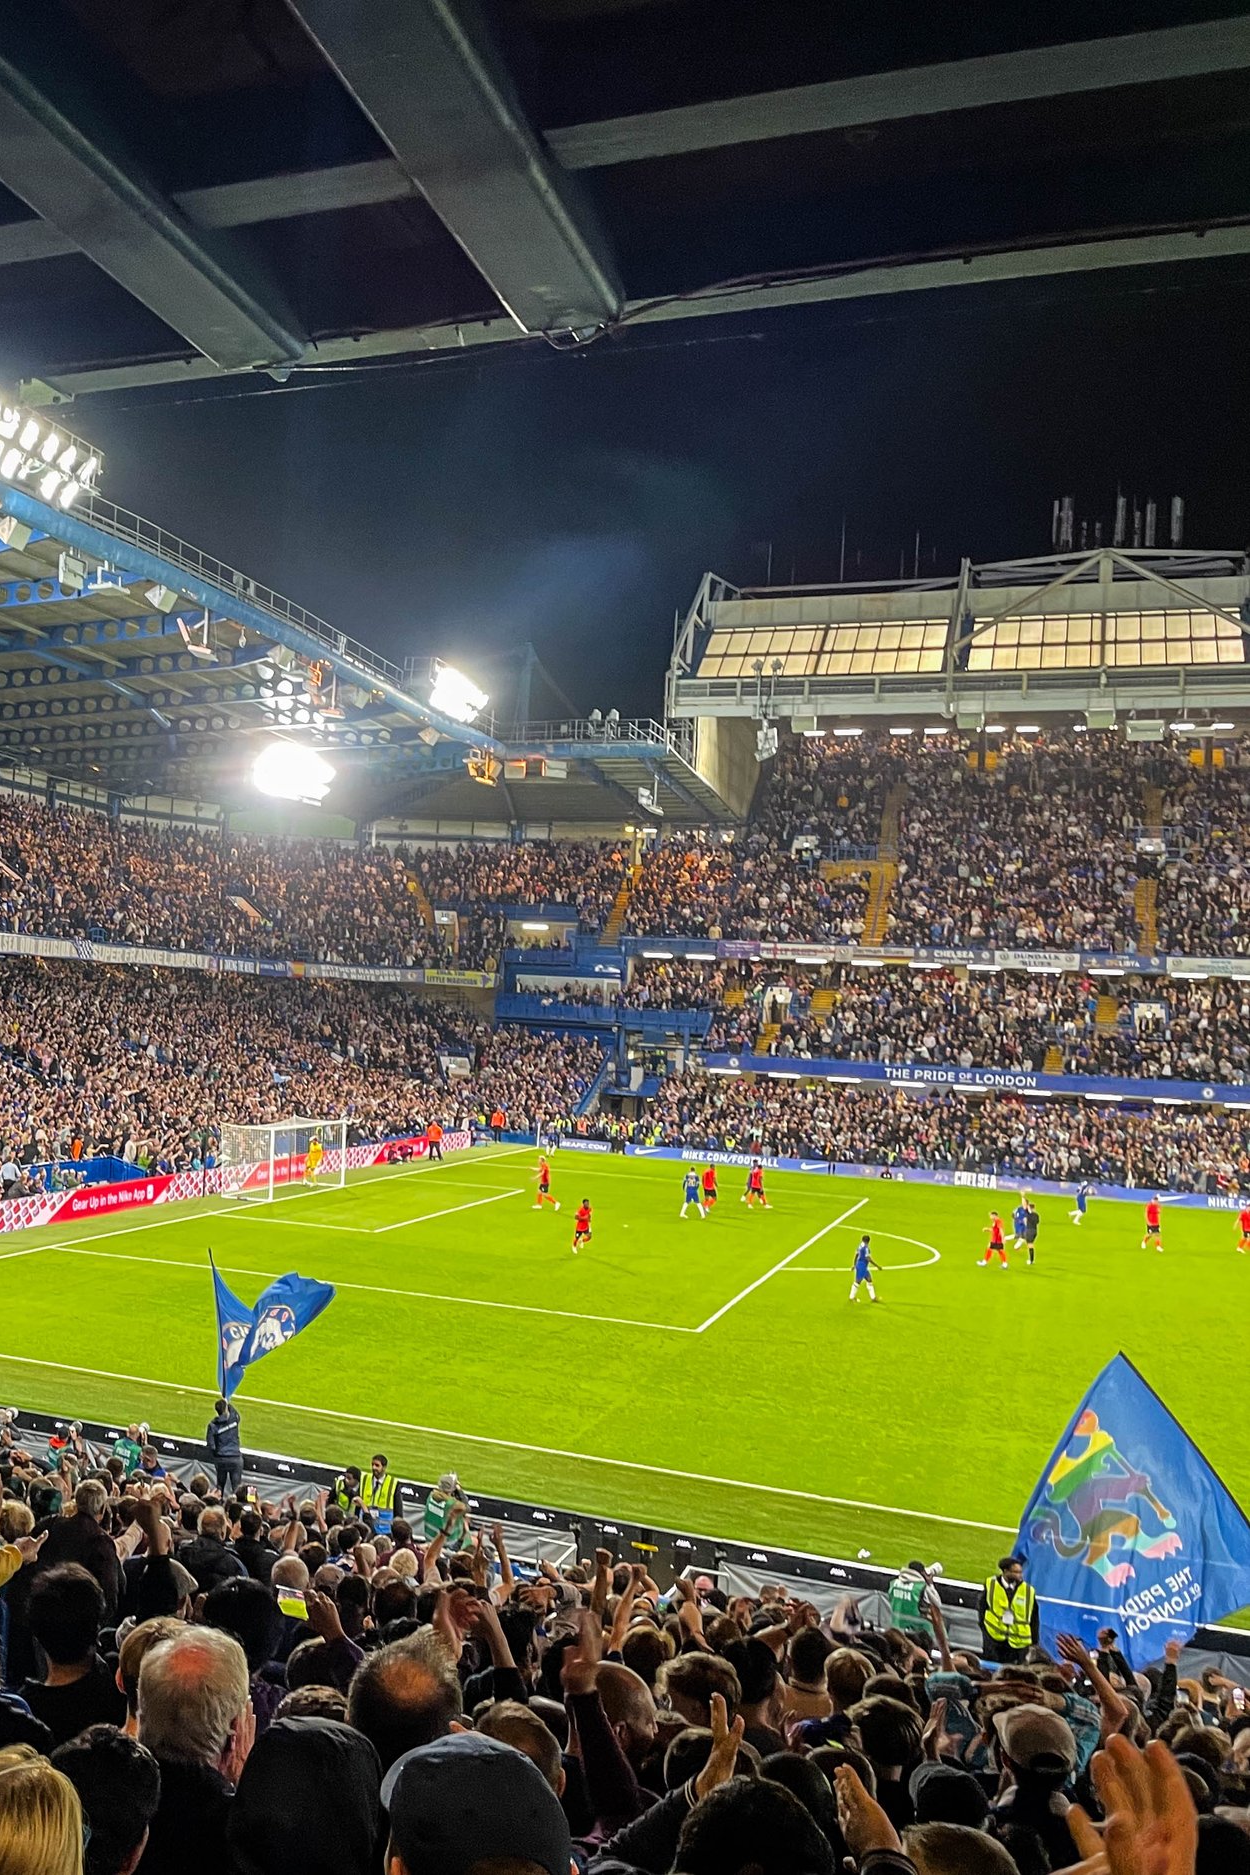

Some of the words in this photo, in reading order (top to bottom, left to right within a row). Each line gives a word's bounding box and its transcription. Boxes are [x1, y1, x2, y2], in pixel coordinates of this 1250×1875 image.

[93, 945, 122, 961] SUPER
[933, 949, 975, 959] CHELSEA
[884, 1067, 910, 1079] THE
[914, 1069, 956, 1082] PRIDE
[959, 1072, 972, 1082] OF
[976, 1073, 1037, 1087] LONDON
[953, 1170, 998, 1189] CHELSEA
[72, 1198, 88, 1212] Gear
[89, 1195, 99, 1210] Up
[100, 1193, 107, 1207] in
[107, 1192, 117, 1206] the
[118, 1190, 132, 1203] Nike
[133, 1188, 145, 1202] App
